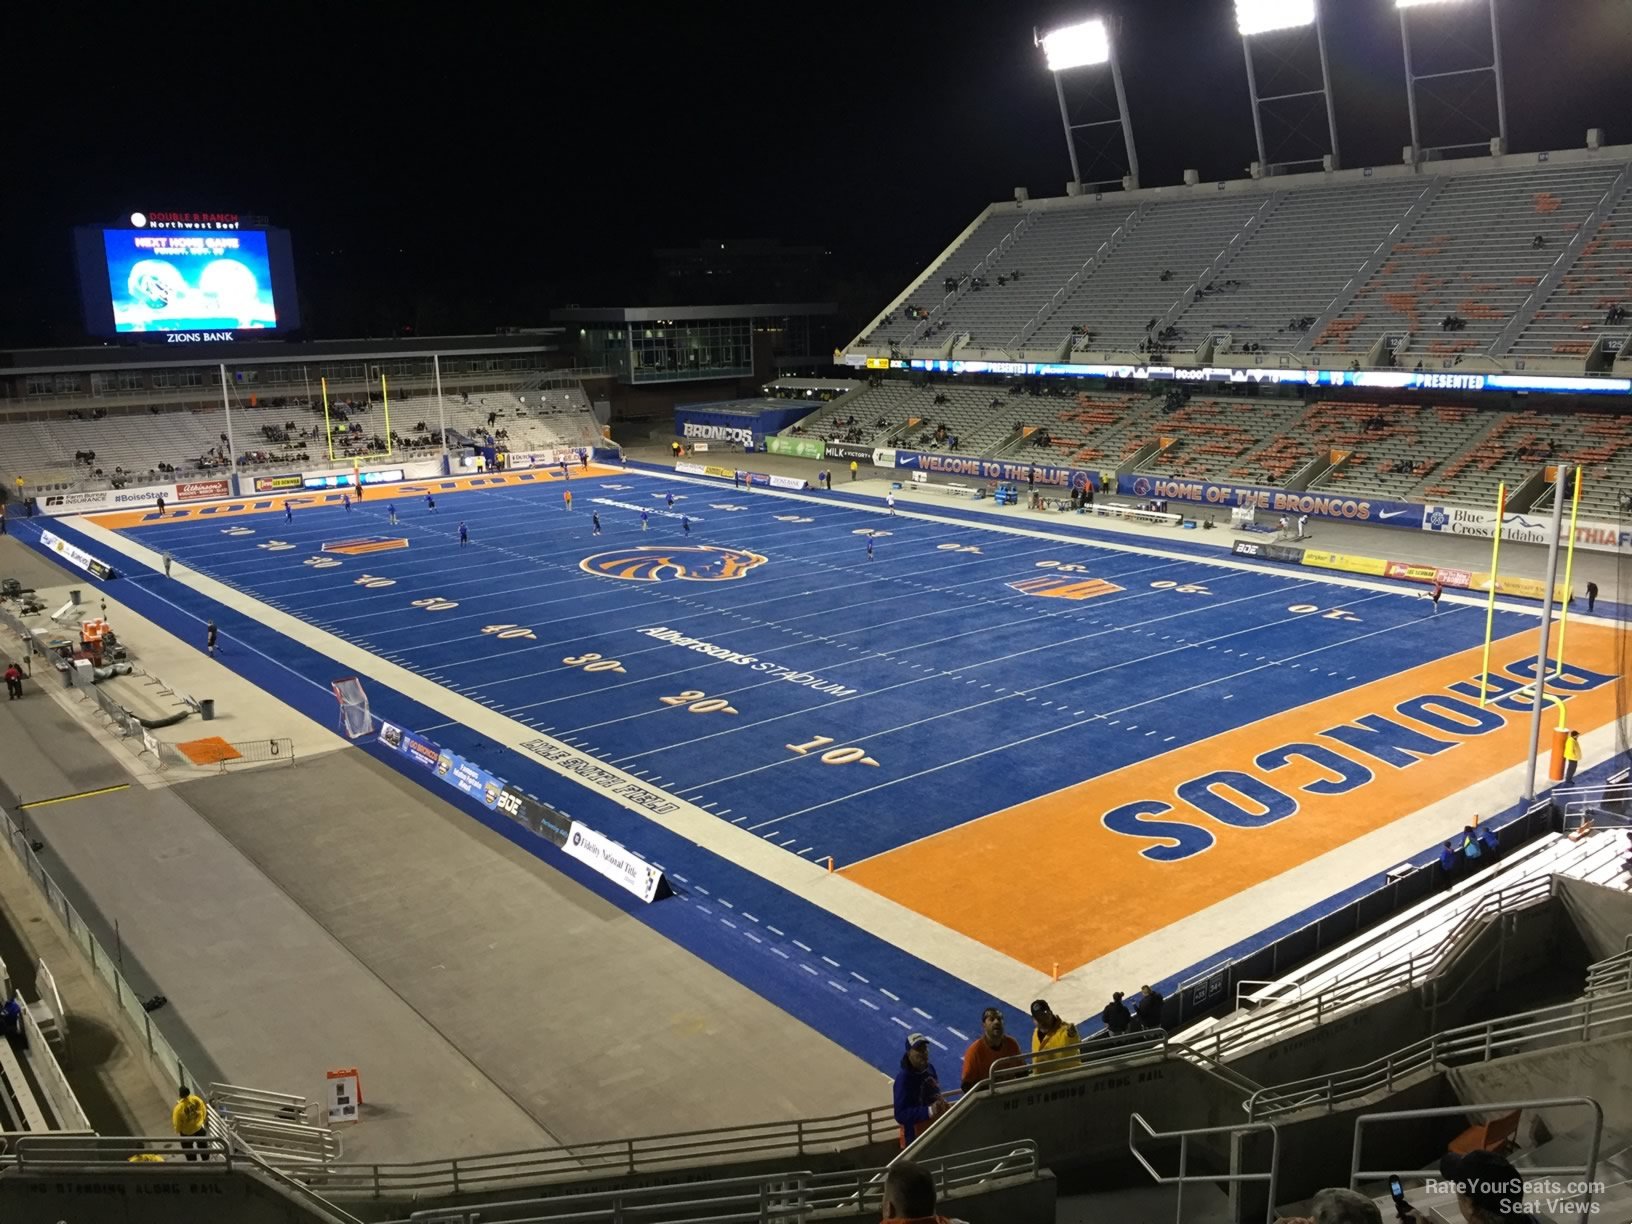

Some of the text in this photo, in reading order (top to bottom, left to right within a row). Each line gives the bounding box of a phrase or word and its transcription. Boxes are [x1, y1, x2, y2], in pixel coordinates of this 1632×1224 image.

[150, 212, 190, 222] DOUBLE
[201, 213, 238, 222] RANCH
[150, 221, 239, 230] Northwest Beef
[134, 237, 167, 248] NEXT
[167, 332, 233, 343] ZIONS BANK
[1608, 341, 1623, 349] 125
[1416, 373, 1484, 389] PRESENTED
[683, 423, 753, 444] BRONCOS
[826, 447, 844, 458] MILK
[918, 455, 1069, 486] WELCOME TO THE BLUE
[115, 490, 169, 503] #BoiseState
[1155, 480, 1370, 520] HOME OF THE BRONCOS
[1453, 509, 1484, 523] Blue
[1452, 522, 1488, 536] Cross
[1507, 528, 1544, 542] Idaho
[411, 597, 459, 611] 50
[481, 624, 533, 639] 40
[562, 653, 621, 672] 30
[636, 626, 858, 697] Albertsons STADIUM
[659, 690, 729, 713] 20
[786, 735, 865, 765] 10
[1101, 654, 1620, 862] BRONCOS
[520, 739, 680, 815] LYLE SMITH FIELD
[580, 838, 638, 879] Fidelity National Title
[1003, 1069, 1164, 1110] NO STANDING ALONG RAIL
[56, 1183, 126, 1195] STANDING
[135, 1183, 181, 1194] ALONG
[190, 1182, 222, 1194] RAIL
